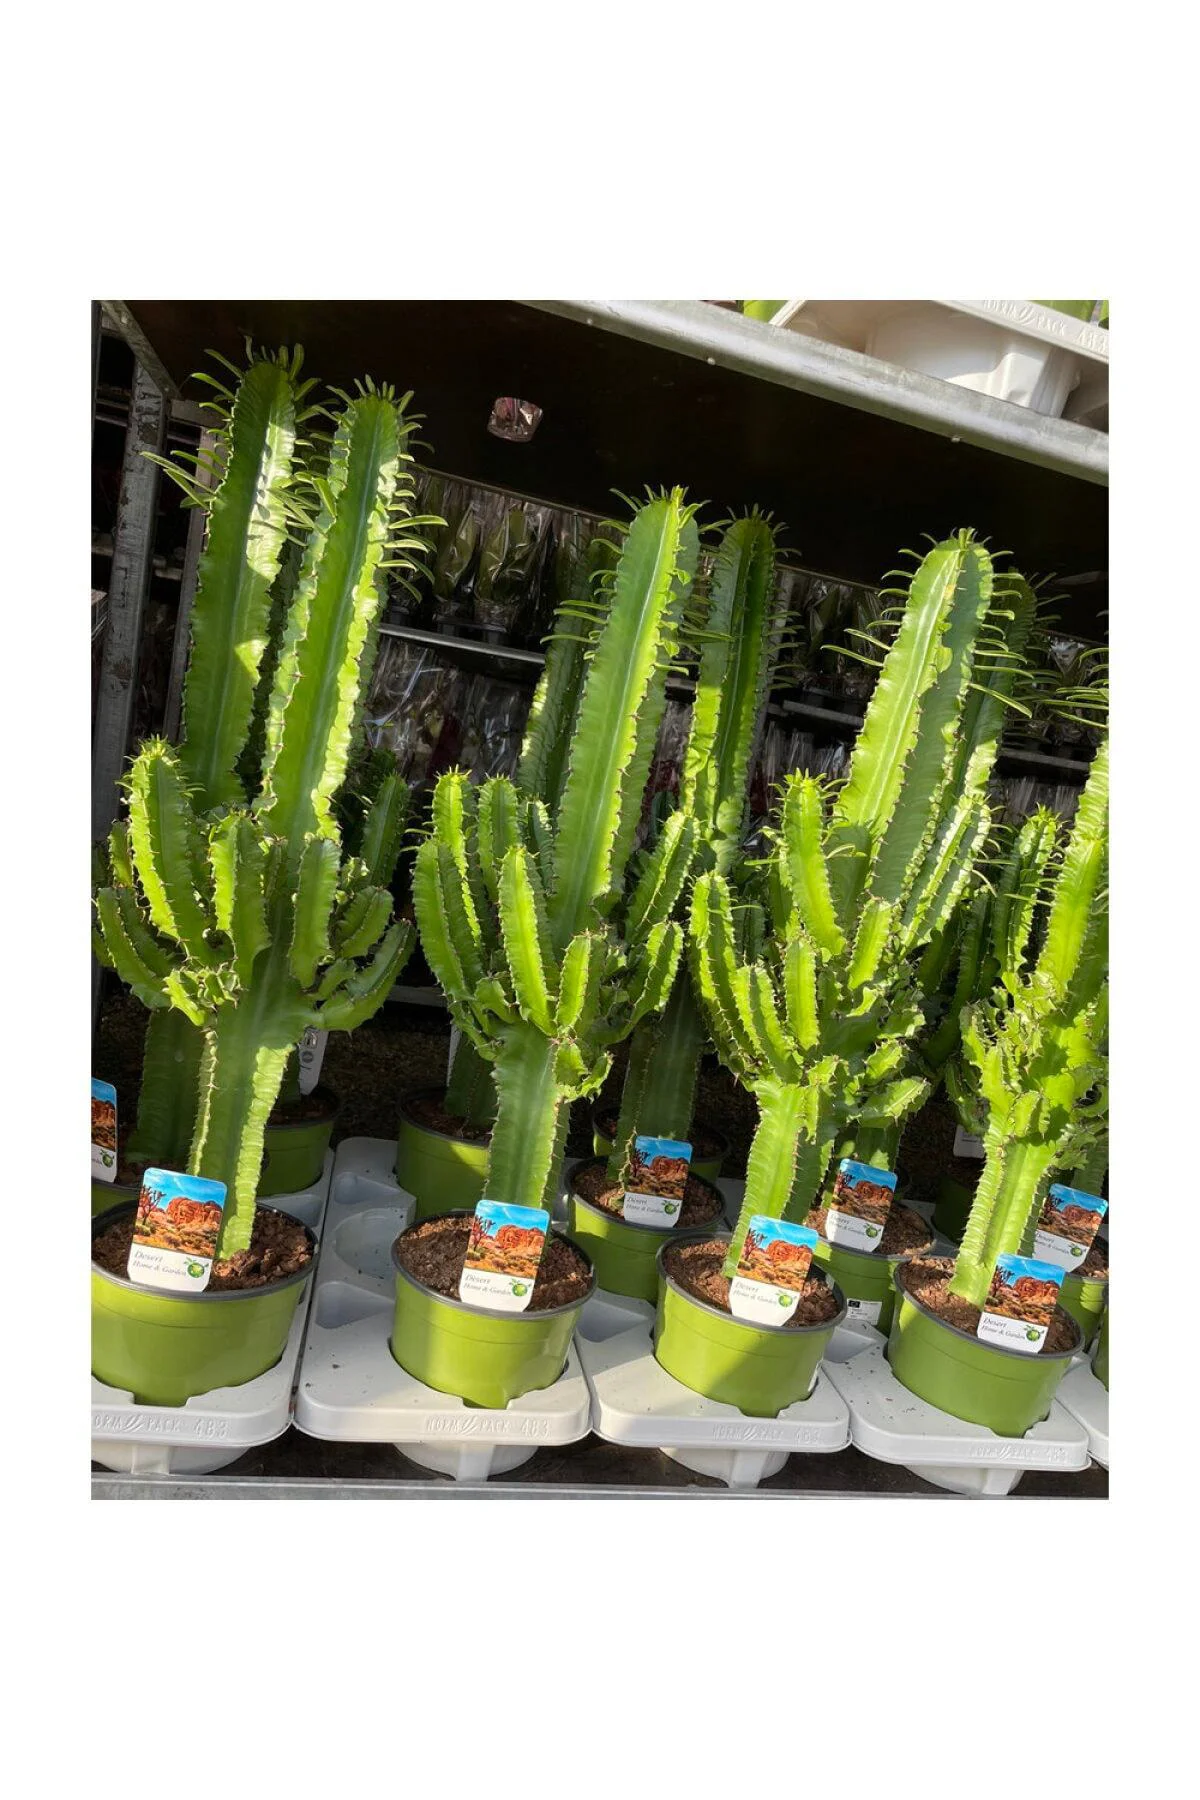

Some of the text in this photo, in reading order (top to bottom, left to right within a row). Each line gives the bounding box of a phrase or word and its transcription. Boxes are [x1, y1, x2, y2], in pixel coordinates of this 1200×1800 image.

[134, 1249, 163, 1263] Desert
[132, 1260, 153, 1270] Home
[161, 1265, 187, 1277] Garden
[465, 1273, 491, 1285] Desert
[463, 1282, 481, 1291] Home
[489, 1286, 511, 1296] Garden
[735, 1281, 759, 1293] Desert
[983, 1317, 1007, 1329] Desert
[981, 1325, 998, 1334] Home
